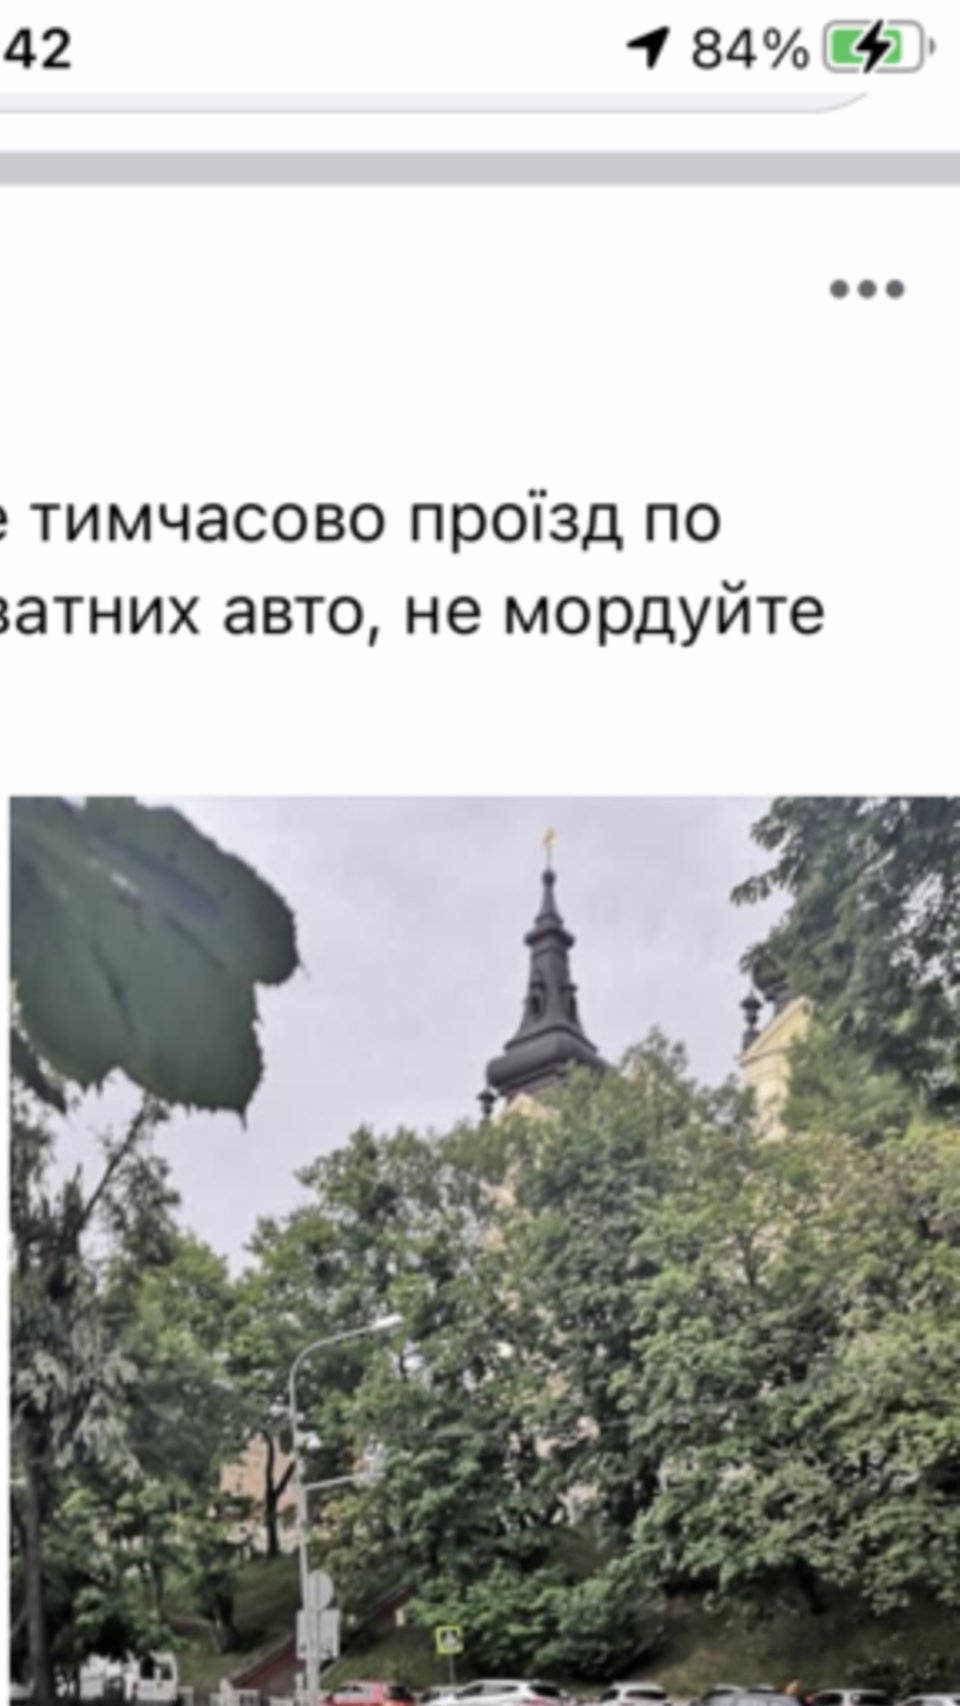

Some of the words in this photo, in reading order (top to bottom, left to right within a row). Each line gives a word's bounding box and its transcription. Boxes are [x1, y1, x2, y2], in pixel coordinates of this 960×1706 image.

[690, 25, 811, 72] 84%
[28, 501, 387, 545] тимчасово
[409, 488, 626, 556] проїзд
[644, 501, 723, 545] по
[221, 593, 381, 649] авто,
[404, 593, 483, 638] не
[503, 578, 826, 650] мордуйте
